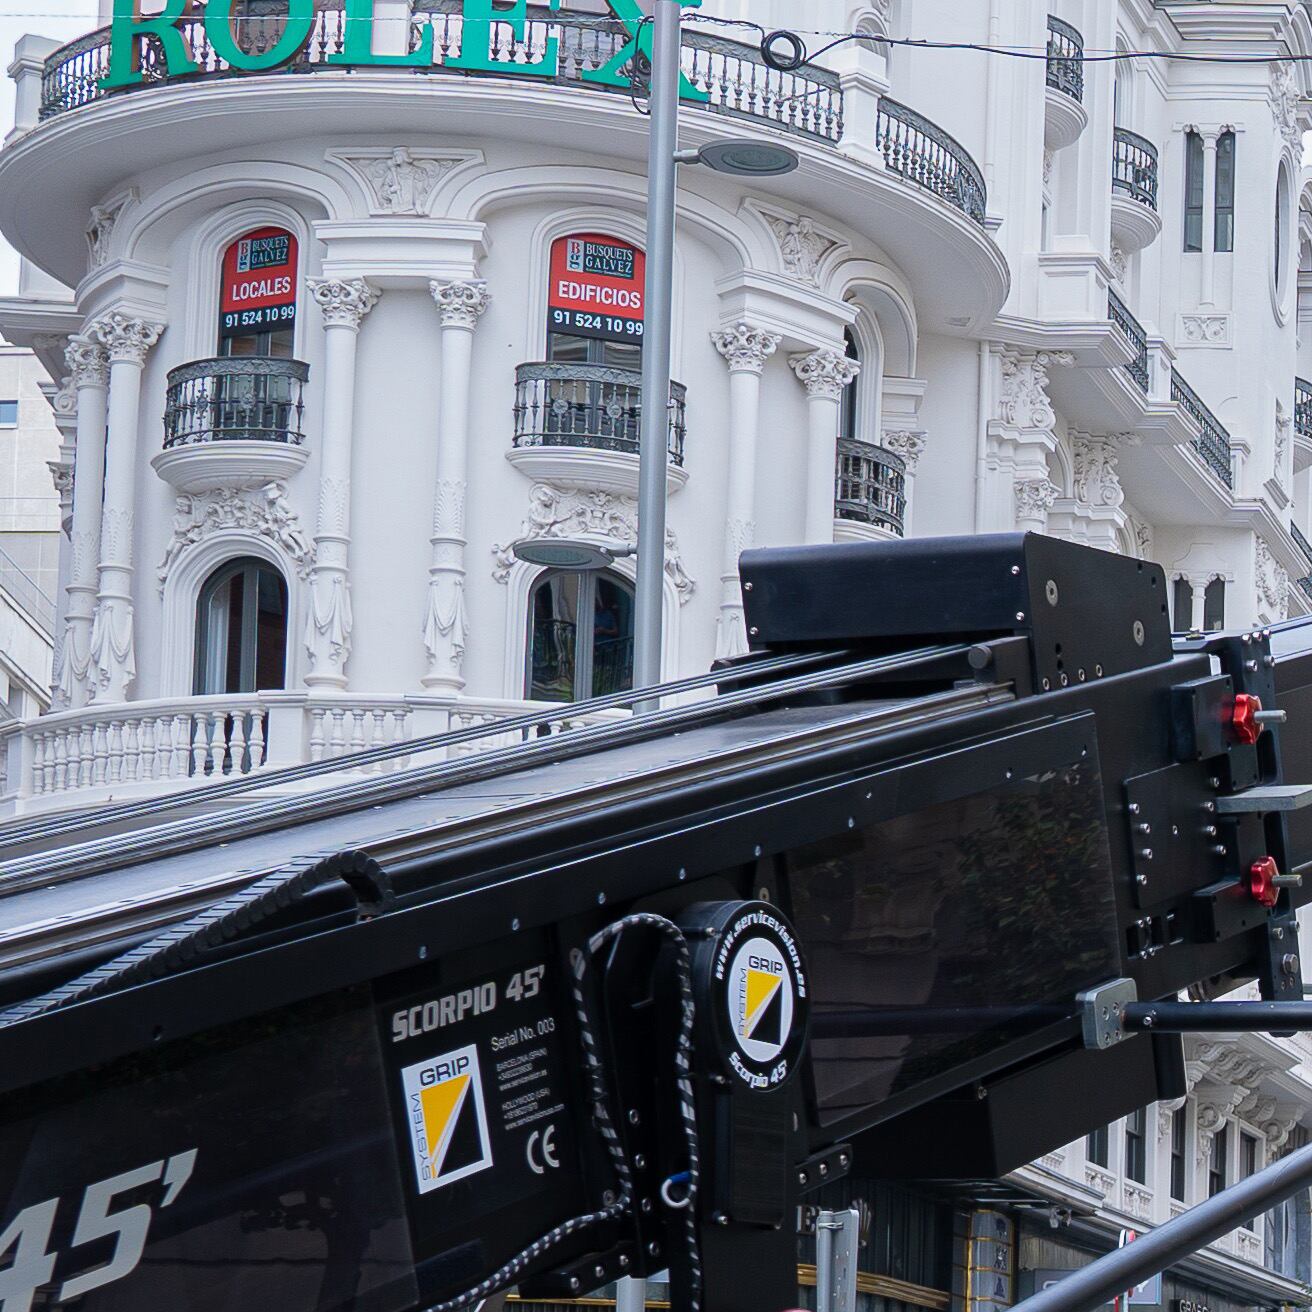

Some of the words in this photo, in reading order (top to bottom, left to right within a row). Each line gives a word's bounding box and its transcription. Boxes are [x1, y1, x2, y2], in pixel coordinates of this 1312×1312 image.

[99, 0, 709, 102] ROLEX
[251, 249, 287, 264] GALVEZ
[252, 236, 289, 251] BUSQUETS
[586, 243, 633, 261] BUSQUETS
[585, 256, 632, 273] GALVEZ
[233, 277, 291, 301] LOCALES
[559, 281, 641, 309] EDIFICIOS
[225, 314, 239, 328] 91
[242, 311, 262, 326] 524
[266, 308, 279, 322] 10
[281, 306, 295, 319] 99
[554, 310, 570, 325] 91
[575, 314, 602, 330] 524
[606, 318, 623, 333] 10
[626, 321, 644, 336] 99
[749, 955, 784, 974] GRIP
[393, 982, 496, 1043] SCORPIO
[506, 965, 545, 1001] 45'
[738, 968, 748, 1036] SYSTEM
[491, 1029, 518, 1052] Serial
[519, 1026, 536, 1042] No.
[537, 1017, 555, 1036] 003
[420, 1055, 469, 1087] GRIP
[728, 1051, 769, 1089] Scorpio
[410, 1093, 432, 1181] SYSTEM
